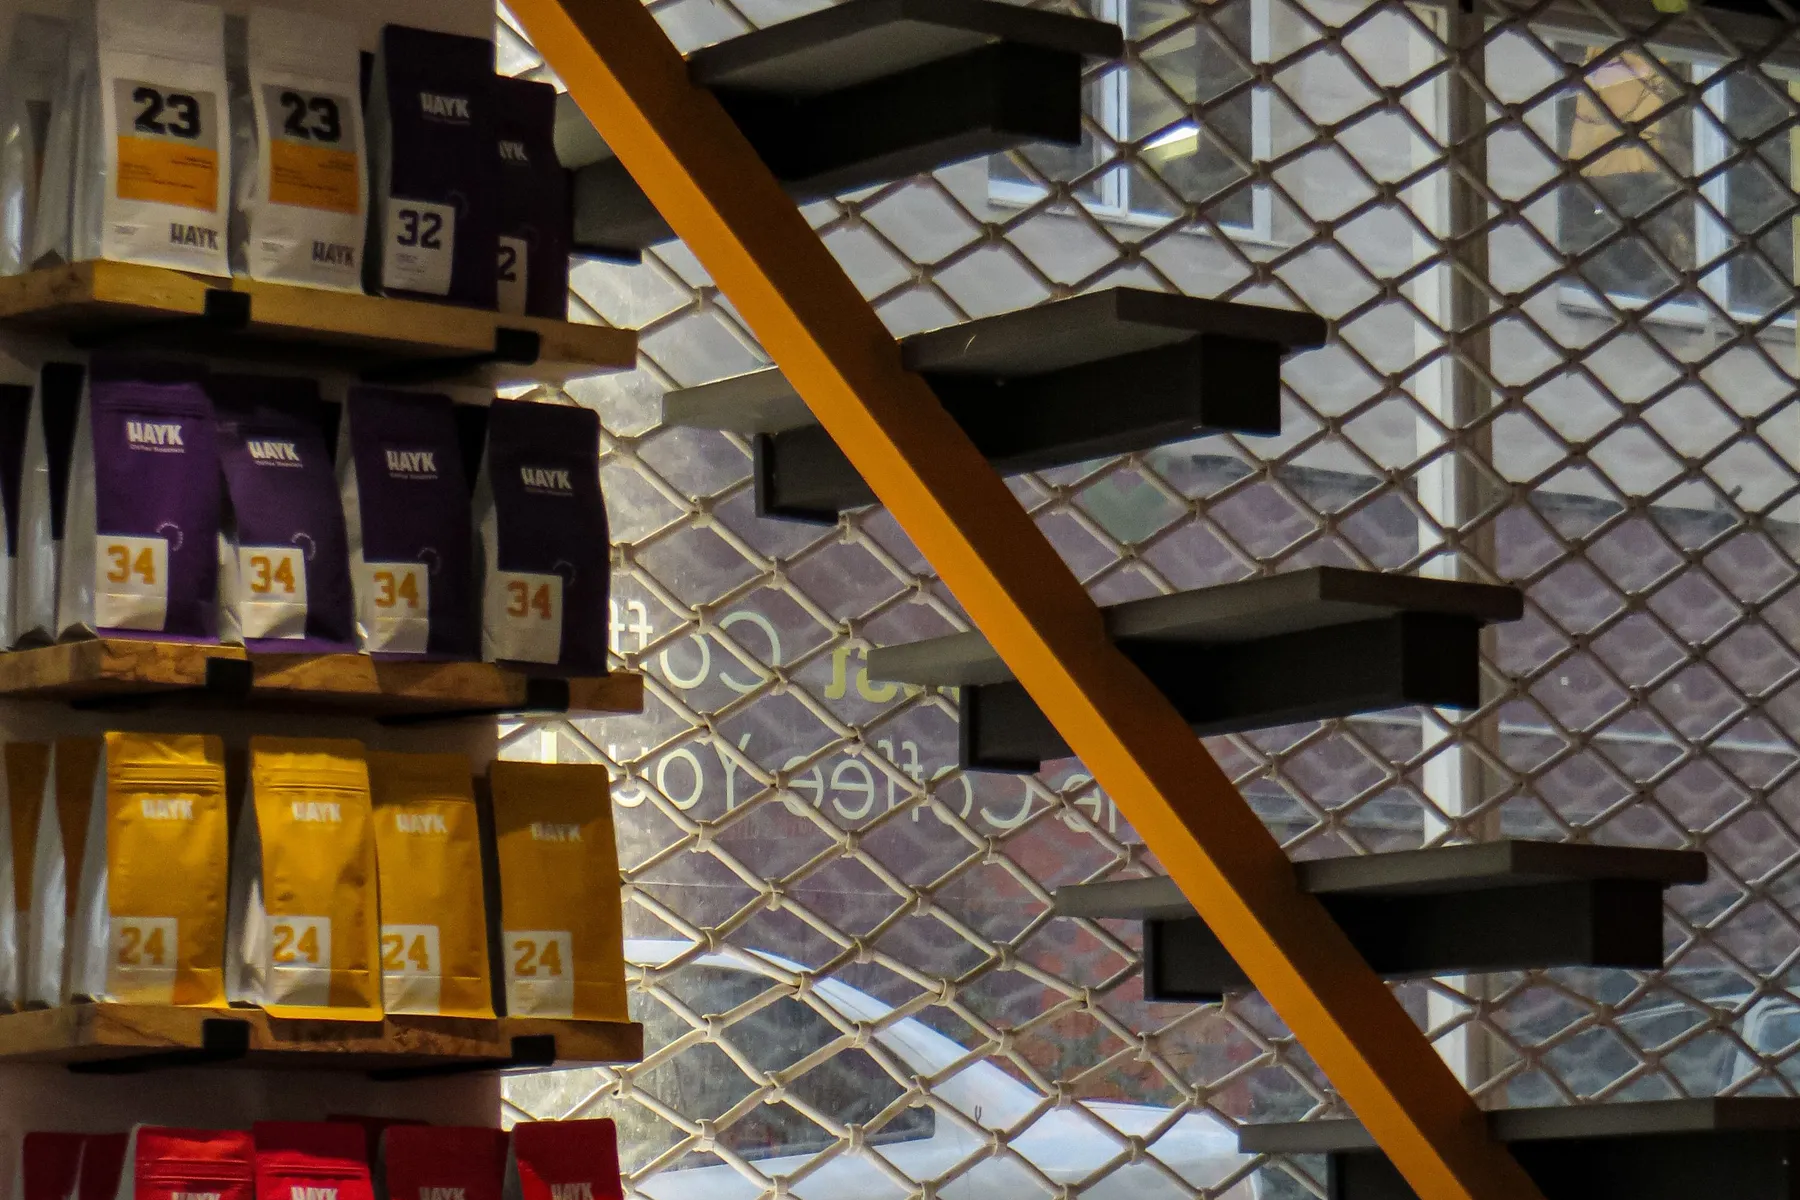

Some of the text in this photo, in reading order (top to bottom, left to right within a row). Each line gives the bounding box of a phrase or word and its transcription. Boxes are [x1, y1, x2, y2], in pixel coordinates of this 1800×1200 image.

[132, 86, 202, 140] 23
[280, 91, 343, 143] 23
[170, 222, 219, 250] HAYK
[396, 209, 443, 250] 32
[126, 421, 184, 446] HAYK
[247, 441, 300, 462] HAYK
[385, 450, 437, 472] HAYK
[520, 467, 573, 490] HAYK
[106, 544, 156, 585] 34
[250, 555, 296, 594] 34
[373, 571, 420, 609] 34
[506, 579, 552, 620] 34
[118, 926, 165, 965] 24
[272, 924, 320, 963] 24
[381, 934, 429, 972] 24
[514, 938, 562, 976] 24
